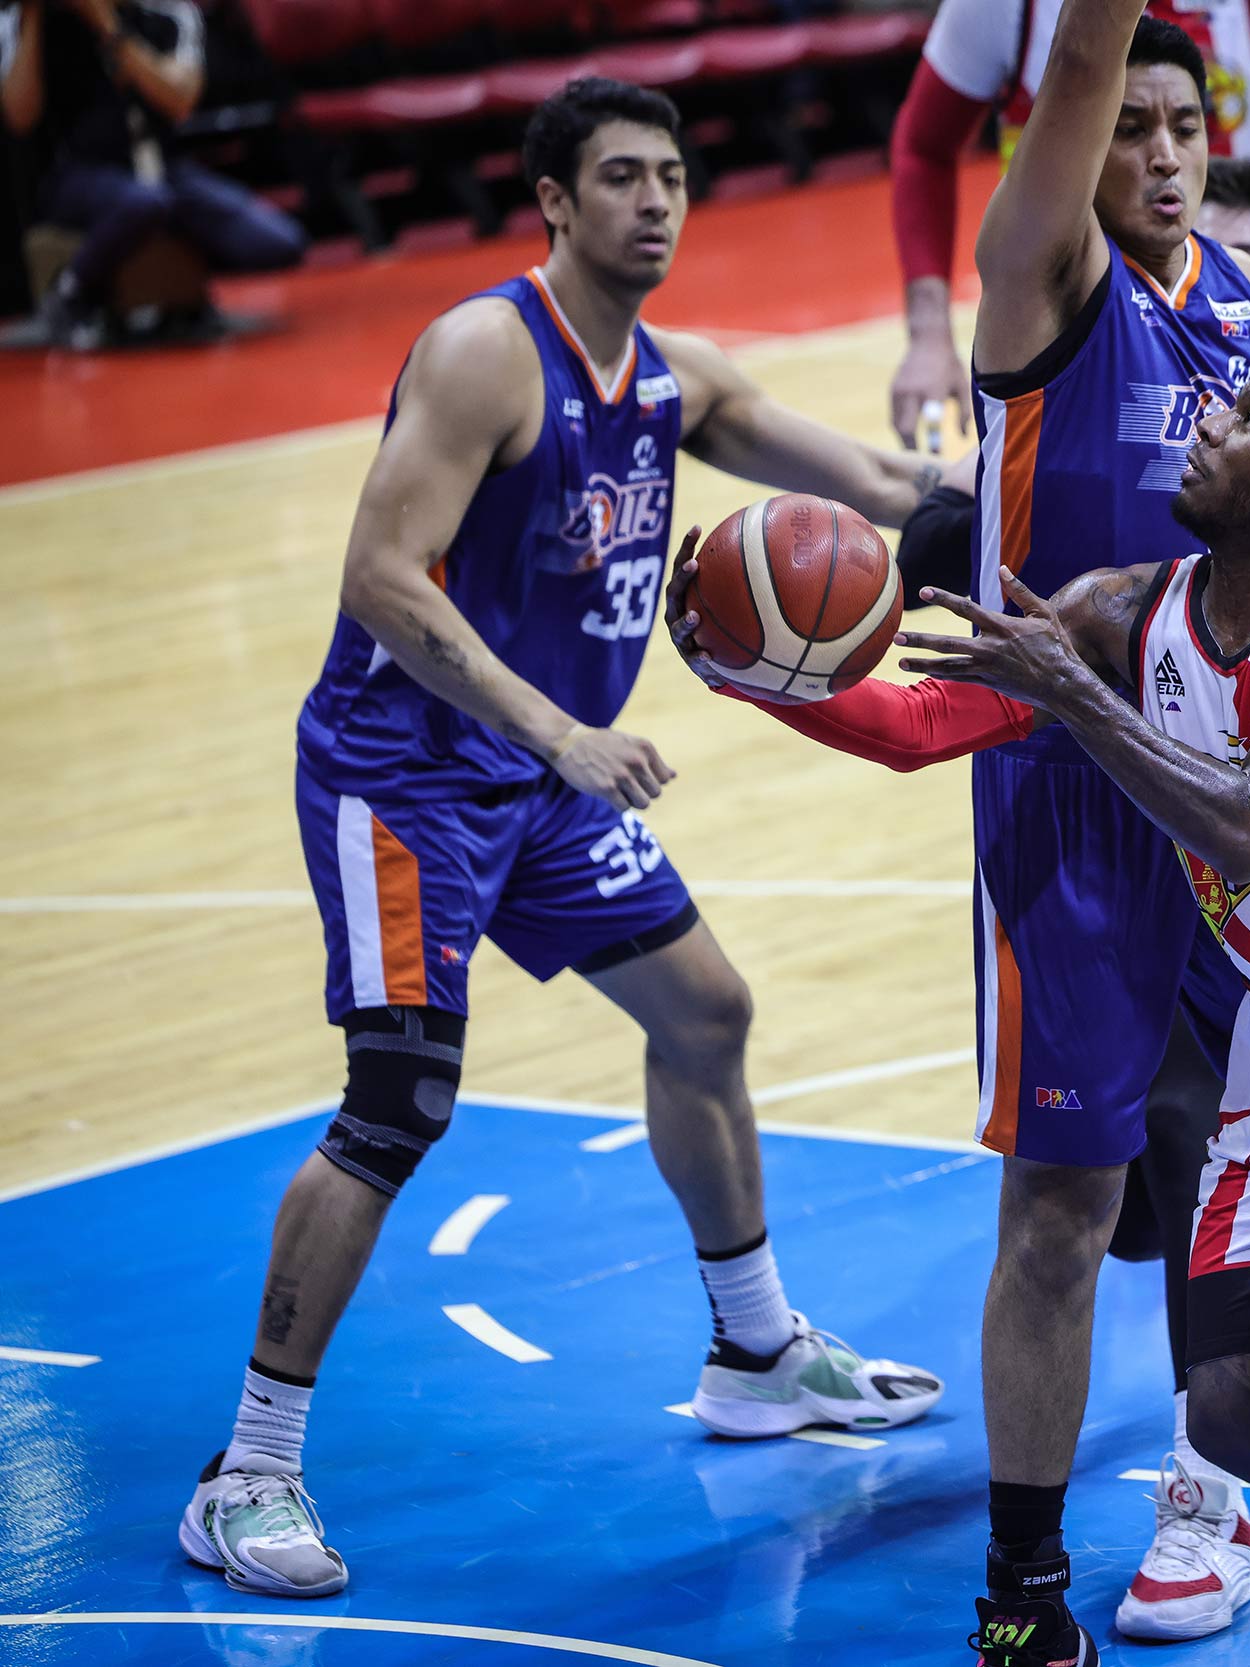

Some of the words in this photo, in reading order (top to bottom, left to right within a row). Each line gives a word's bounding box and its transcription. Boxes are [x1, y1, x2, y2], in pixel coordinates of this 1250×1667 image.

[581, 555, 662, 641] 33
[1157, 683, 1186, 697] ELTA
[588, 811, 663, 899] 33
[1036, 1087, 1083, 1110] PBA
